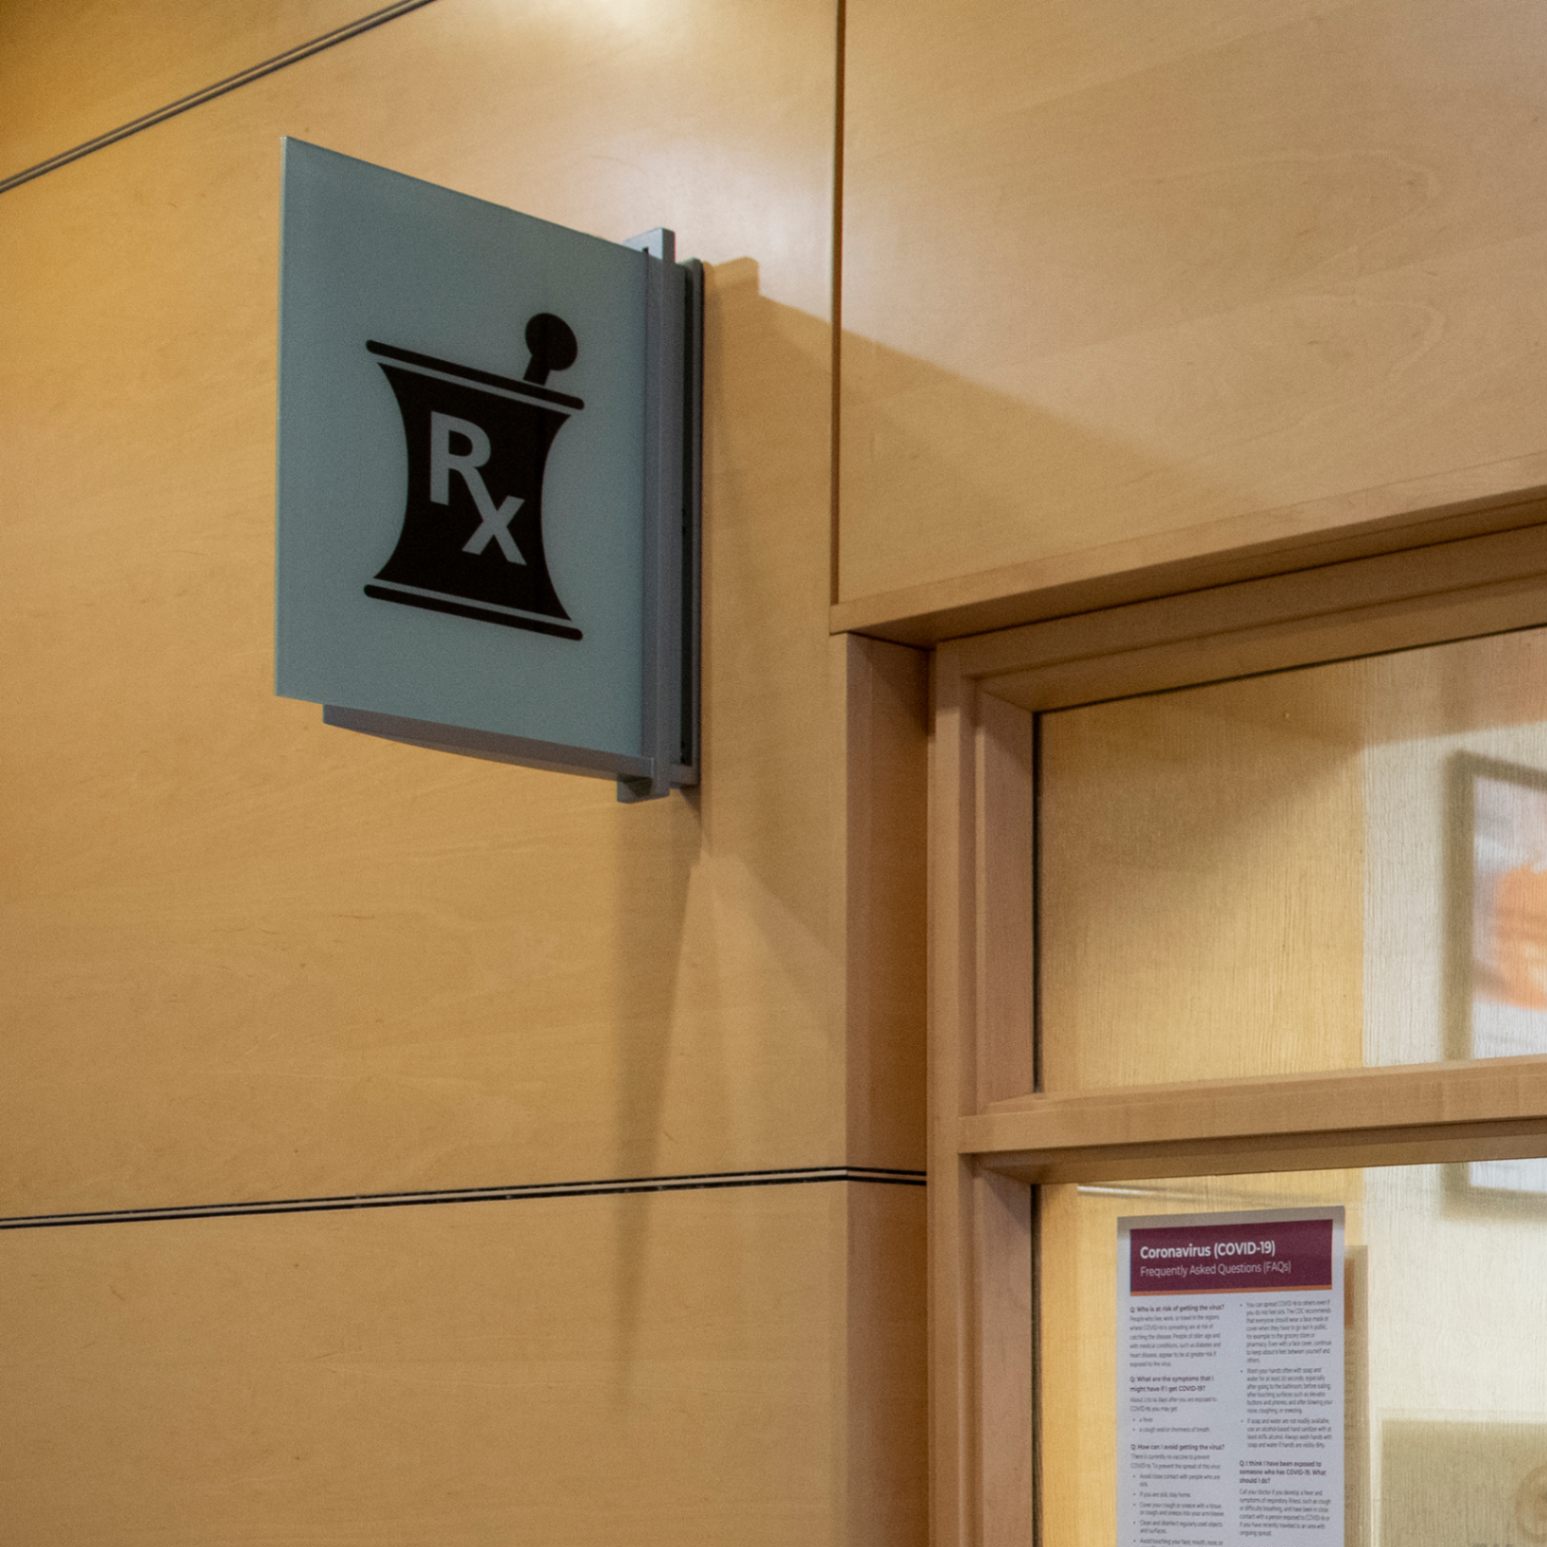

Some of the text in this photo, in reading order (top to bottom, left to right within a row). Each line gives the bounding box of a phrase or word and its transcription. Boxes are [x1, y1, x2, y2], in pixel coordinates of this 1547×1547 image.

[1140, 1240, 1275, 1259] Coronavirus (COVID-19)
[1140, 1260, 1291, 1277] Frequently Asked Questions (FAQs)
